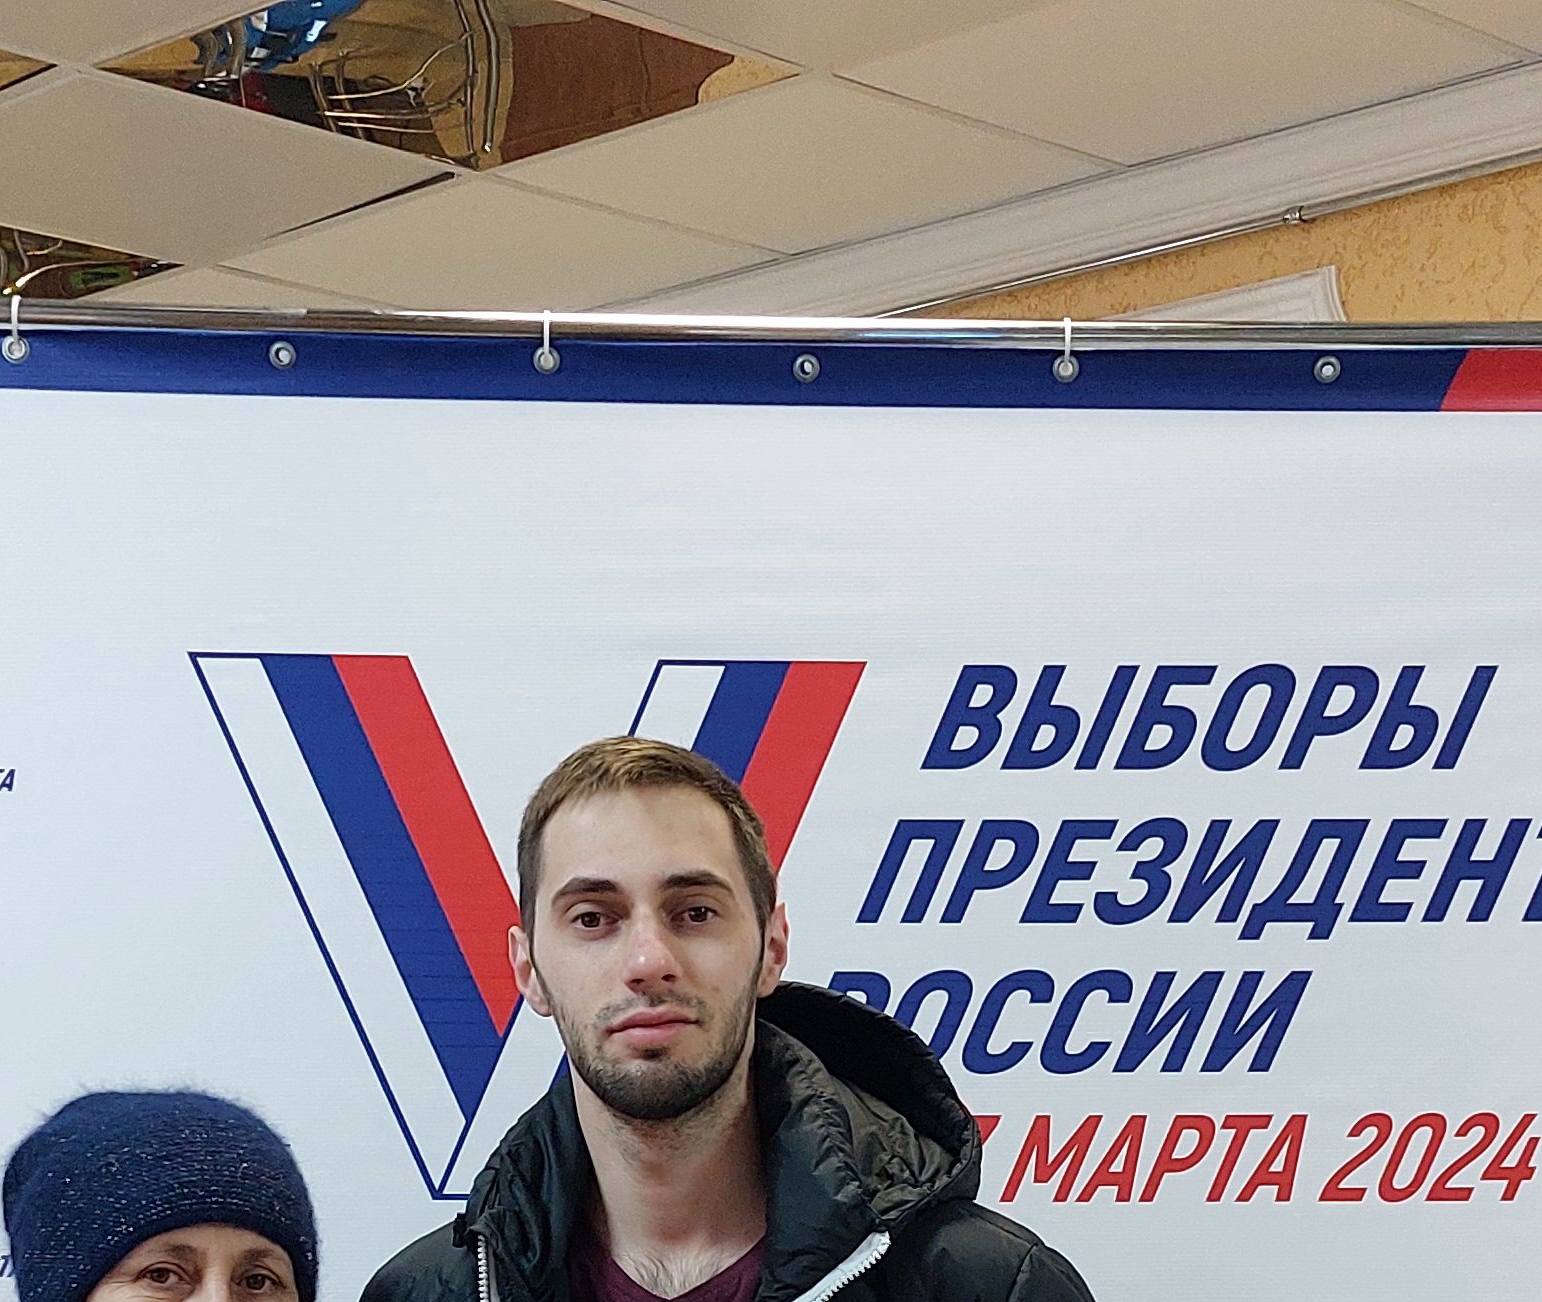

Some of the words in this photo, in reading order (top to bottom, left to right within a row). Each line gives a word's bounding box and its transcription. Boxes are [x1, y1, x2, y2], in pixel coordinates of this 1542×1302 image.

[919, 663, 1499, 772] ВЫБОРЫ
[998, 1113, 1308, 1203] МАРТА
[1318, 1112, 1541, 1203] 2024
